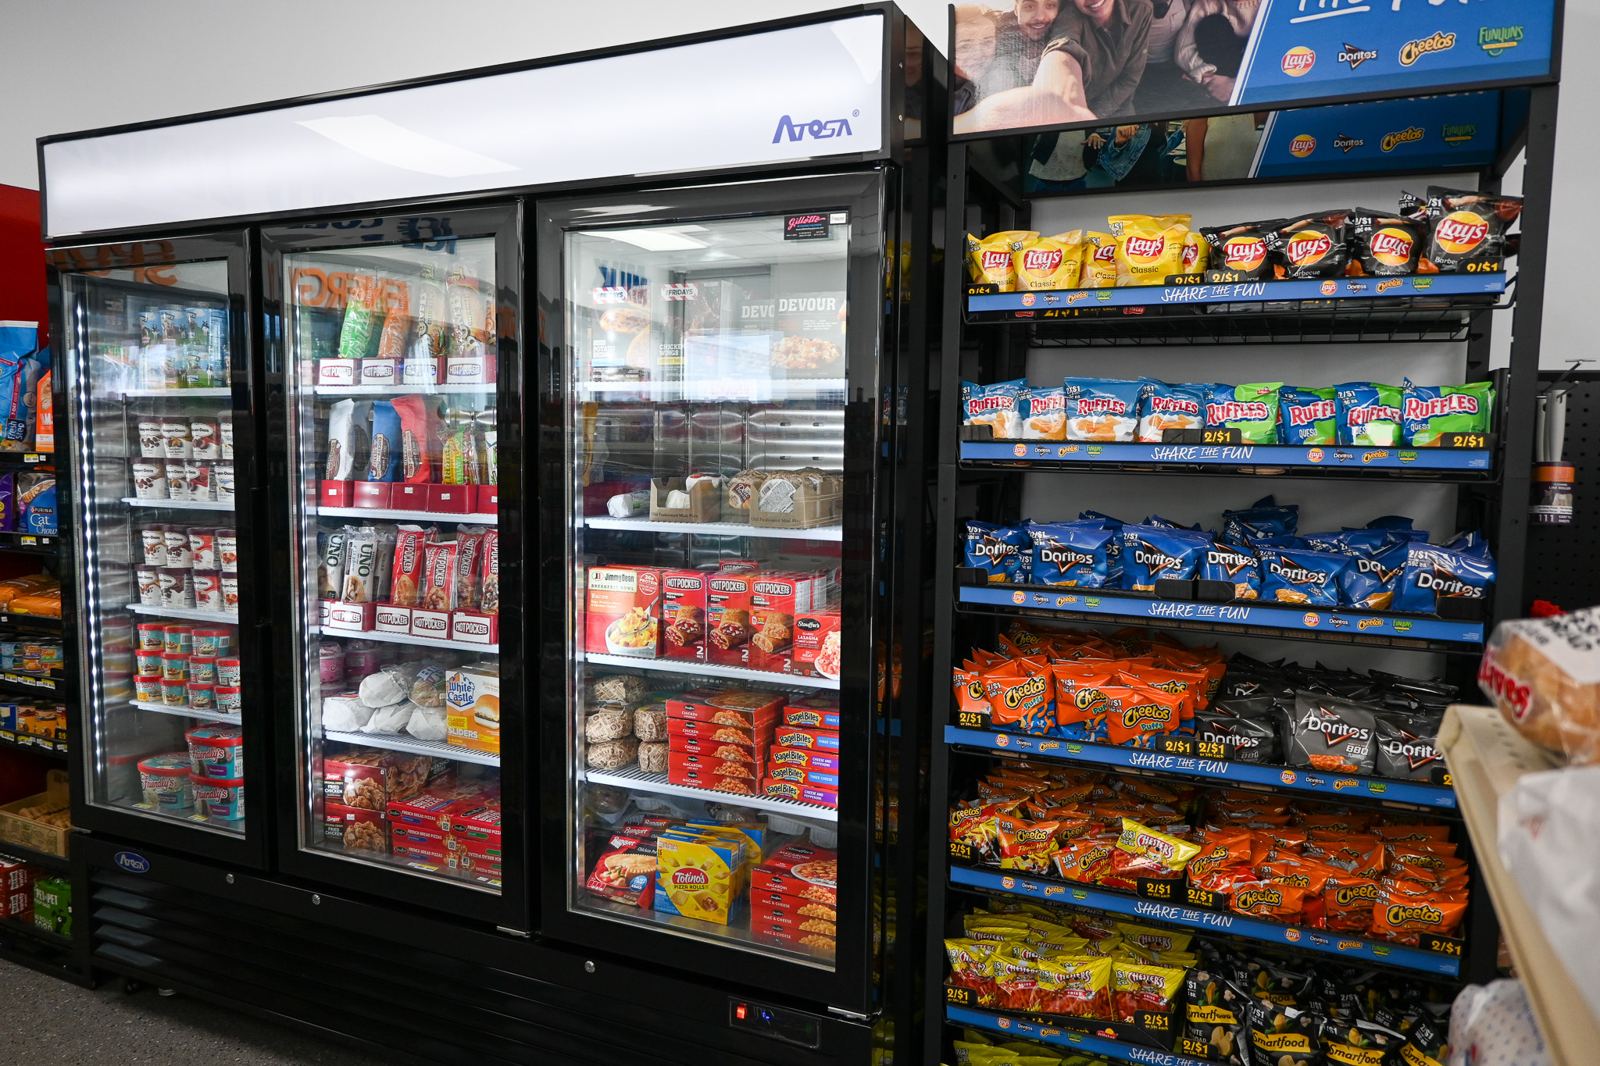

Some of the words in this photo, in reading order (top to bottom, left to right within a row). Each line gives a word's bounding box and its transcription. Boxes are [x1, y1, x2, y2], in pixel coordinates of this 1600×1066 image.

[1479, 25, 1524, 44] FUNYUNS
[1338, 50, 1377, 63] Doritos
[1400, 33, 1454, 66] Cheetos
[1283, 52, 1314, 70] Lay's
[1290, 137, 1316, 152] Lay's
[1333, 138, 1364, 149] Doritos
[1381, 127, 1425, 152] Cheetos
[1435, 219, 1489, 243] Lay's
[1126, 235, 1165, 258] Lay's
[1224, 239, 1267, 262] Lay's
[1288, 236, 1331, 262] Lay's
[1370, 231, 1413, 257] Lay's
[1024, 250, 1063, 270] Lay's
[1465, 262, 1500, 273] 2/$1
[1130, 265, 1159, 275] Classic
[1211, 272, 1240, 283] 2/$1
[668, 288, 694, 296] FRIDAYS
[1161, 286, 1208, 302] SHARE
[1210, 285, 1230, 297] THE
[1232, 282, 1266, 297] FUN
[741, 304, 775, 319] DEVO
[778, 297, 837, 313] DEVOUR
[969, 395, 1014, 414] RUFFLES
[1078, 398, 1126, 416] RUFFLES
[1151, 396, 1199, 415] RUFFLES
[1405, 394, 1479, 419] RUFFLES
[1205, 402, 1268, 425] RUFFLES
[7, 420, 17, 440] Fresh
[17, 421, 25, 440] Step
[1203, 431, 1231, 443] 2/$1
[1453, 435, 1485, 448] 2/$1
[1151, 447, 1198, 461] SHARE
[1200, 447, 1219, 459] THE
[1222, 446, 1254, 460] FUN
[29, 513, 49, 527] Cat
[327, 534, 343, 568] UNO
[975, 543, 1020, 556] Doritos
[1041, 550, 1094, 565] Doritos
[358, 543, 374, 578] UNO
[1135, 550, 1183, 570] Doritos
[1208, 551, 1259, 568] Doritos
[1270, 562, 1328, 585] Doritos
[1417, 572, 1483, 598] Doritos
[1148, 602, 1194, 618] SHARE
[1197, 605, 1216, 616] THE
[1218, 606, 1250, 620] FUN
[696, 646, 704, 655] 2
[741, 649, 749, 659] 2
[783, 658, 791, 668] 2
[449, 682, 472, 694] White
[1004, 675, 1047, 708] Cheetos
[448, 692, 473, 702] Castle
[1023, 695, 1044, 710] Puffs
[787, 712, 805, 723] Bagel
[804, 711, 819, 721] Bites
[960, 712, 982, 724] 2/$1
[1122, 703, 1172, 728] Cheetos
[448, 727, 478, 739] SLIDERS
[1140, 722, 1164, 732] Puffs
[1308, 716, 1369, 740] Doritos
[780, 733, 796, 744] Bagel
[796, 732, 811, 744] Bites
[1203, 731, 1260, 748] Doritos
[1165, 740, 1191, 753] 2/$1
[1198, 742, 1225, 754] 2/$1
[774, 751, 791, 762] Bagel
[790, 750, 806, 761] Bites
[1128, 752, 1173, 768] SHARE
[1176, 757, 1195, 769] THE
[1198, 760, 1229, 774] FUN
[771, 768, 788, 778] Bagel
[788, 767, 803, 778] Bites
[766, 784, 782, 794] Bagel
[782, 784, 797, 794] Bites
[951, 807, 981, 825] Cheetos
[1016, 829, 1048, 843] Cheetos
[950, 843, 971, 856] 2/$1
[1080, 847, 1107, 870] Cheetos
[674, 872, 705, 884] Totino's
[1146, 883, 1171, 895] 2/$1
[1187, 889, 1213, 903] 2/$1
[1236, 888, 1280, 910] Cheetos
[1134, 901, 1181, 919] SHARE
[1181, 909, 1201, 922] THE
[1203, 912, 1233, 928] FUN
[1387, 905, 1443, 926] Cheetos
[1431, 939, 1461, 956] 2/$1
[946, 988, 969, 1001] 2/$1
[1143, 1014, 1169, 1027] 2/$1
[1183, 1039, 1208, 1054] 2/$1
[1252, 1030, 1306, 1049] Smartfood
[1128, 1047, 1176, 1066] SHARE
